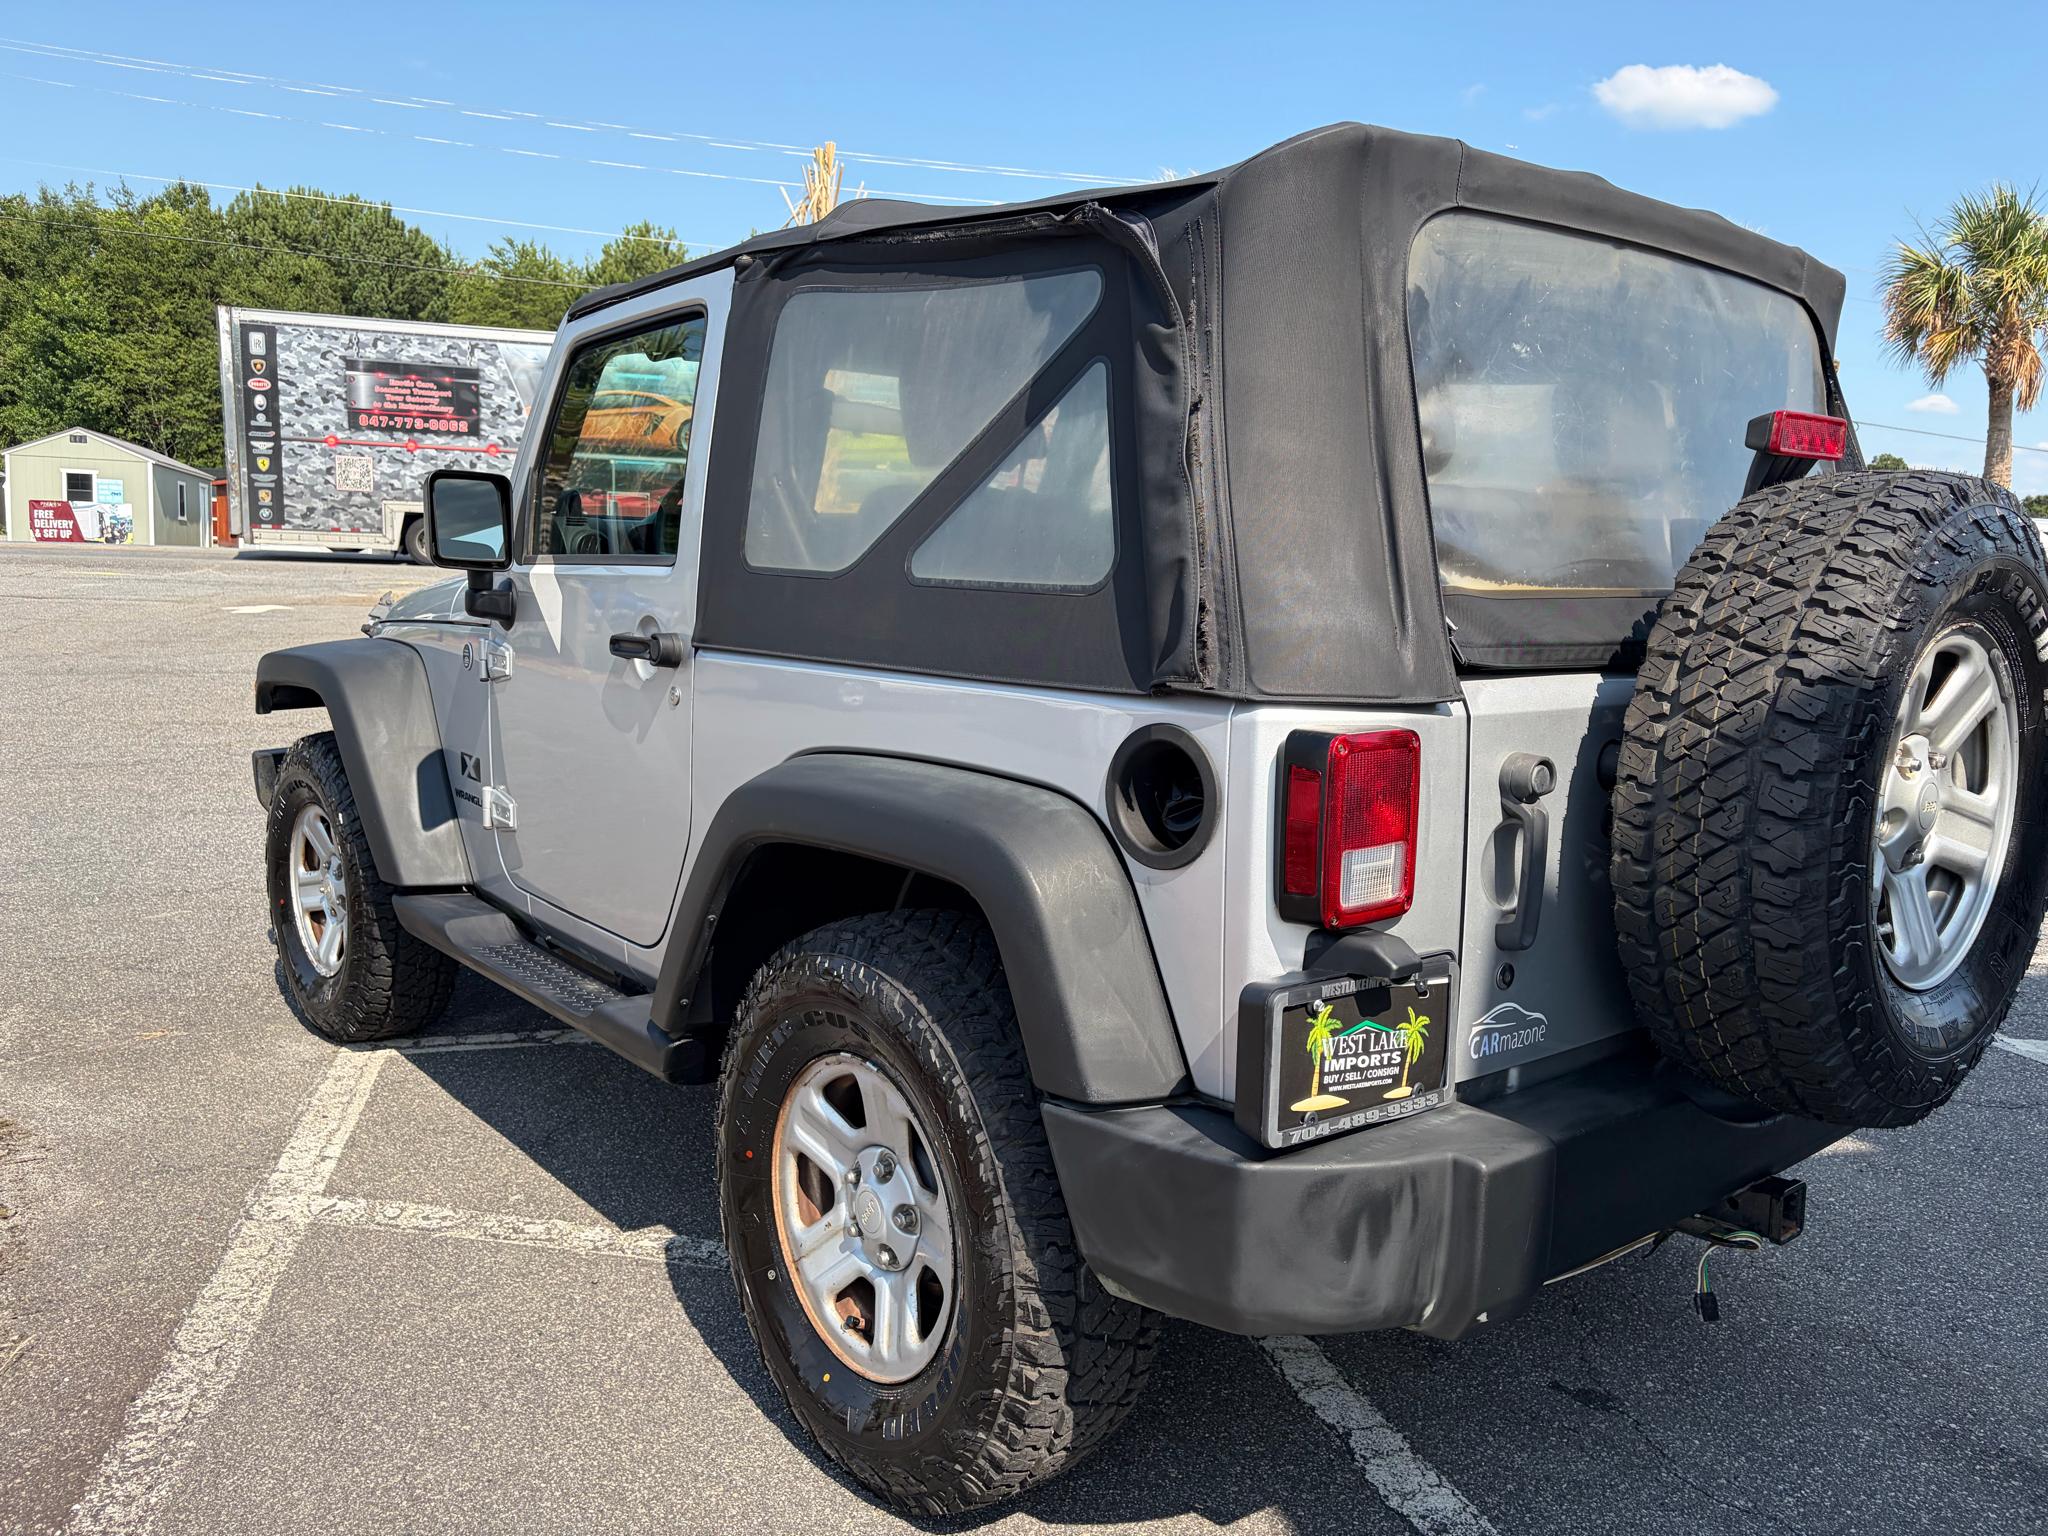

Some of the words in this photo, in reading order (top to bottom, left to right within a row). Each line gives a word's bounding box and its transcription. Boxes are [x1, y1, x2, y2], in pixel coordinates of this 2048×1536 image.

[33, 510, 54, 519] FREE
[34, 519, 74, 529] DELIVERY
[34, 529, 41, 538] &
[43, 529, 58, 538] SET
[60, 529, 72, 539] UP
[455, 787, 483, 807] WRANGL
[1322, 1033, 1366, 1057] WEST
[1370, 1030, 1409, 1051] LAKE
[1470, 1024, 1546, 1060] CARmazone
[1324, 1051, 1402, 1072] IMPORTS
[1323, 1073, 1339, 1084] BUY
[1345, 1071, 1361, 1081] SELL
[1367, 1066, 1400, 1078] CONSIGN
[1289, 1093, 1440, 1144] 704-489-9333
